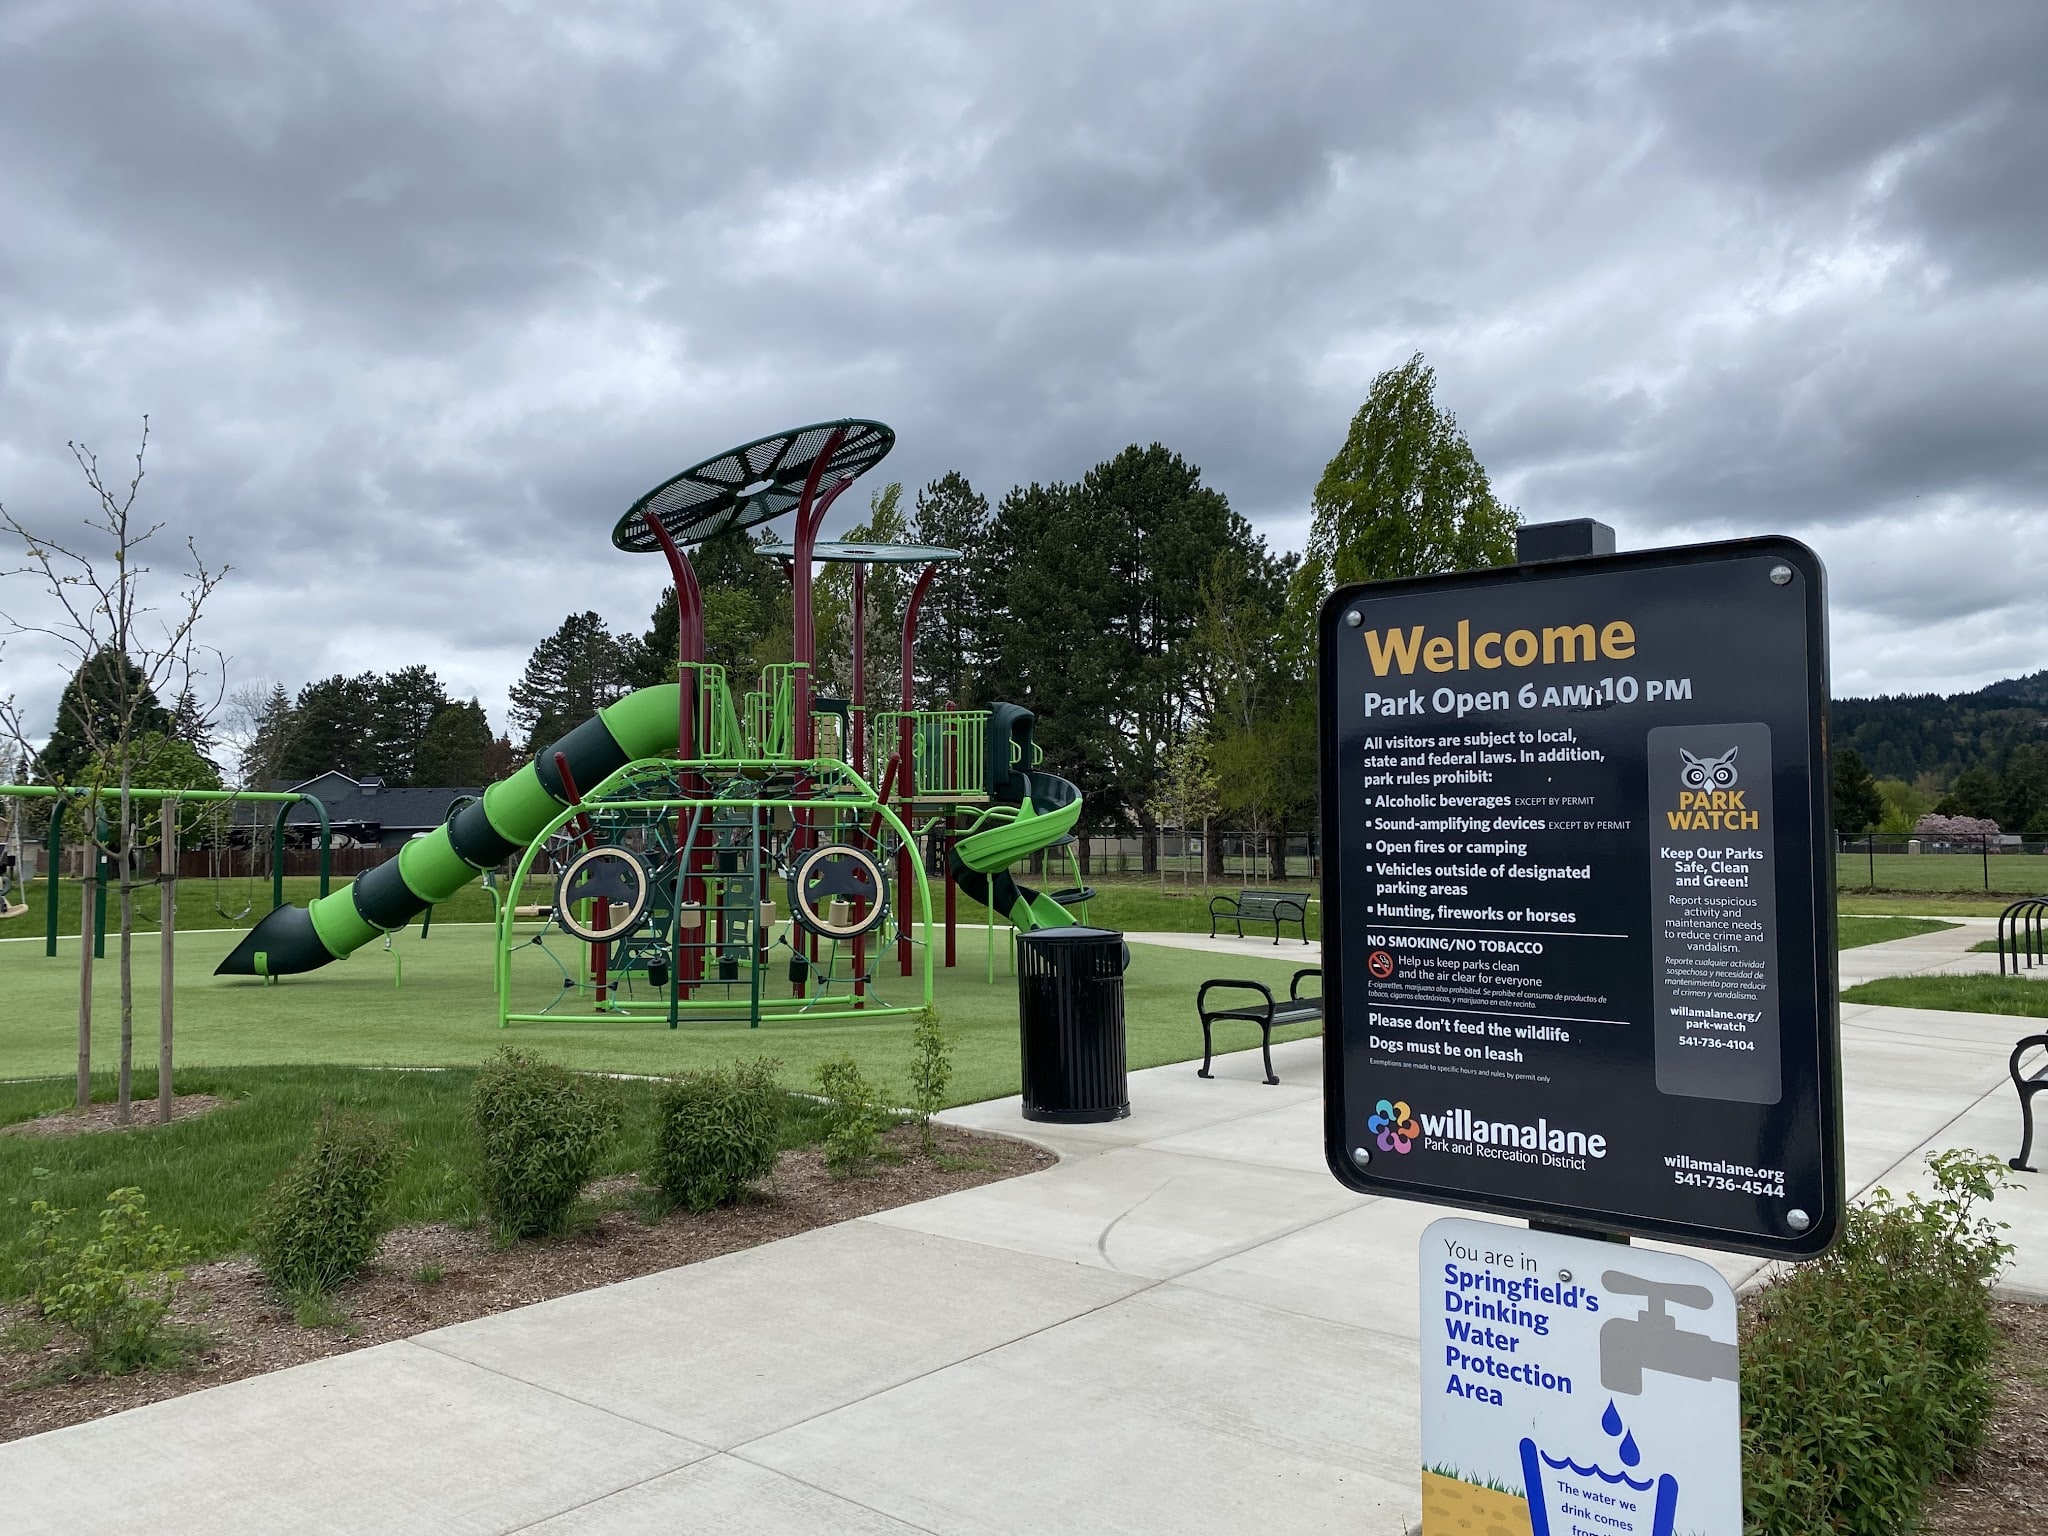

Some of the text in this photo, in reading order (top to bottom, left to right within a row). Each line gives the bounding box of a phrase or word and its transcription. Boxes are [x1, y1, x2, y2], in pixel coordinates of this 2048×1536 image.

[1364, 620, 1636, 676] Welcome
[1365, 689, 1425, 717] Park
[1432, 688, 1509, 718] Open
[1518, 682, 1537, 708] 6
[1646, 678, 1692, 701] PM
[1364, 728, 1577, 750] All visitors are subject to local,
[1364, 747, 1605, 767] state and federal laws. In addition,
[1364, 770, 1492, 788] park rules prohibit:
[1375, 794, 1436, 807] Alcoholic
[1440, 794, 1511, 809] beverages
[1515, 798, 1546, 806] EXCEPT
[1562, 797, 1594, 805] PERMIT
[1680, 791, 1746, 810] PARK
[1375, 816, 1631, 832] Sound-amplifying devices EXCEPT BY PERMIT
[1667, 811, 1758, 830] WATCH
[1376, 840, 1527, 856] Open fires or camping
[1661, 847, 1763, 861] Keep Our Parks
[1376, 863, 1590, 881] Vehicles outside of designated
[1675, 861, 1748, 874] Safe, Clean
[1376, 882, 1468, 897] parking areas
[1676, 875, 1748, 887] and Green!
[1669, 895, 1757, 907] Report suspicious
[1377, 903, 1576, 923] Hunting, fireworks or horses
[1684, 907, 1741, 919] activity and
[1666, 919, 1762, 930] maintenance needs
[1367, 935, 1543, 954] NO SMOKING/NO TOBACCO
[1664, 930, 1763, 942] to reduce crime and
[1687, 942, 1740, 952] vandalism.
[1398, 955, 1421, 968] Help
[1437, 957, 1460, 970] keep
[1462, 959, 1490, 970] parks
[1492, 960, 1520, 972] clean
[1665, 956, 1765, 968] Reporte cualquier actividad
[1398, 969, 1542, 988] and the air clear for everyone
[1666, 968, 1708, 976] sospechosa
[1715, 970, 1753, 978] necesidad
[1754, 971, 1764, 979] de
[1404, 984, 1435, 992] marijuana
[1449, 986, 1481, 995] prohibited.
[1564, 994, 1597, 1003] productos
[1598, 995, 1607, 1003] de
[1665, 978, 1720, 987] mantenimiento
[1740, 981, 1767, 990] reducir
[1457, 997, 1489, 1005] marijuana
[1713, 991, 1758, 1000] vandalismo.
[1670, 1006, 1762, 1023] willamalane.org/
[1369, 1013, 1569, 1042] Please don't feed the wildlife
[1686, 1019, 1746, 1032] park-watch
[1370, 1035, 1523, 1062] Dogs must be on leash
[1679, 1036, 1755, 1051] 541-736-4104
[1370, 1057, 1402, 1067] Exemptions
[1460, 1067, 1477, 1075] hours
[1506, 1071, 1514, 1080] by
[1537, 1075, 1550, 1083] only
[1420, 1108, 1606, 1158] willamalane
[1425, 1137, 1586, 1170] Park and Recreation District
[1664, 1155, 1784, 1183] willamalane.org
[1675, 1171, 1785, 1198] 541-736-4544
[1444, 1239, 1536, 1272] You are in
[1445, 1263, 1599, 1312] Springfield's
[1445, 1290, 1549, 1336] Drinking
[1445, 1318, 1519, 1352] Water
[1446, 1345, 1571, 1394] Protection
[1446, 1374, 1502, 1406] Area
[1557, 1480, 1636, 1512] The water we
[1561, 1502, 1633, 1531] drink comes
